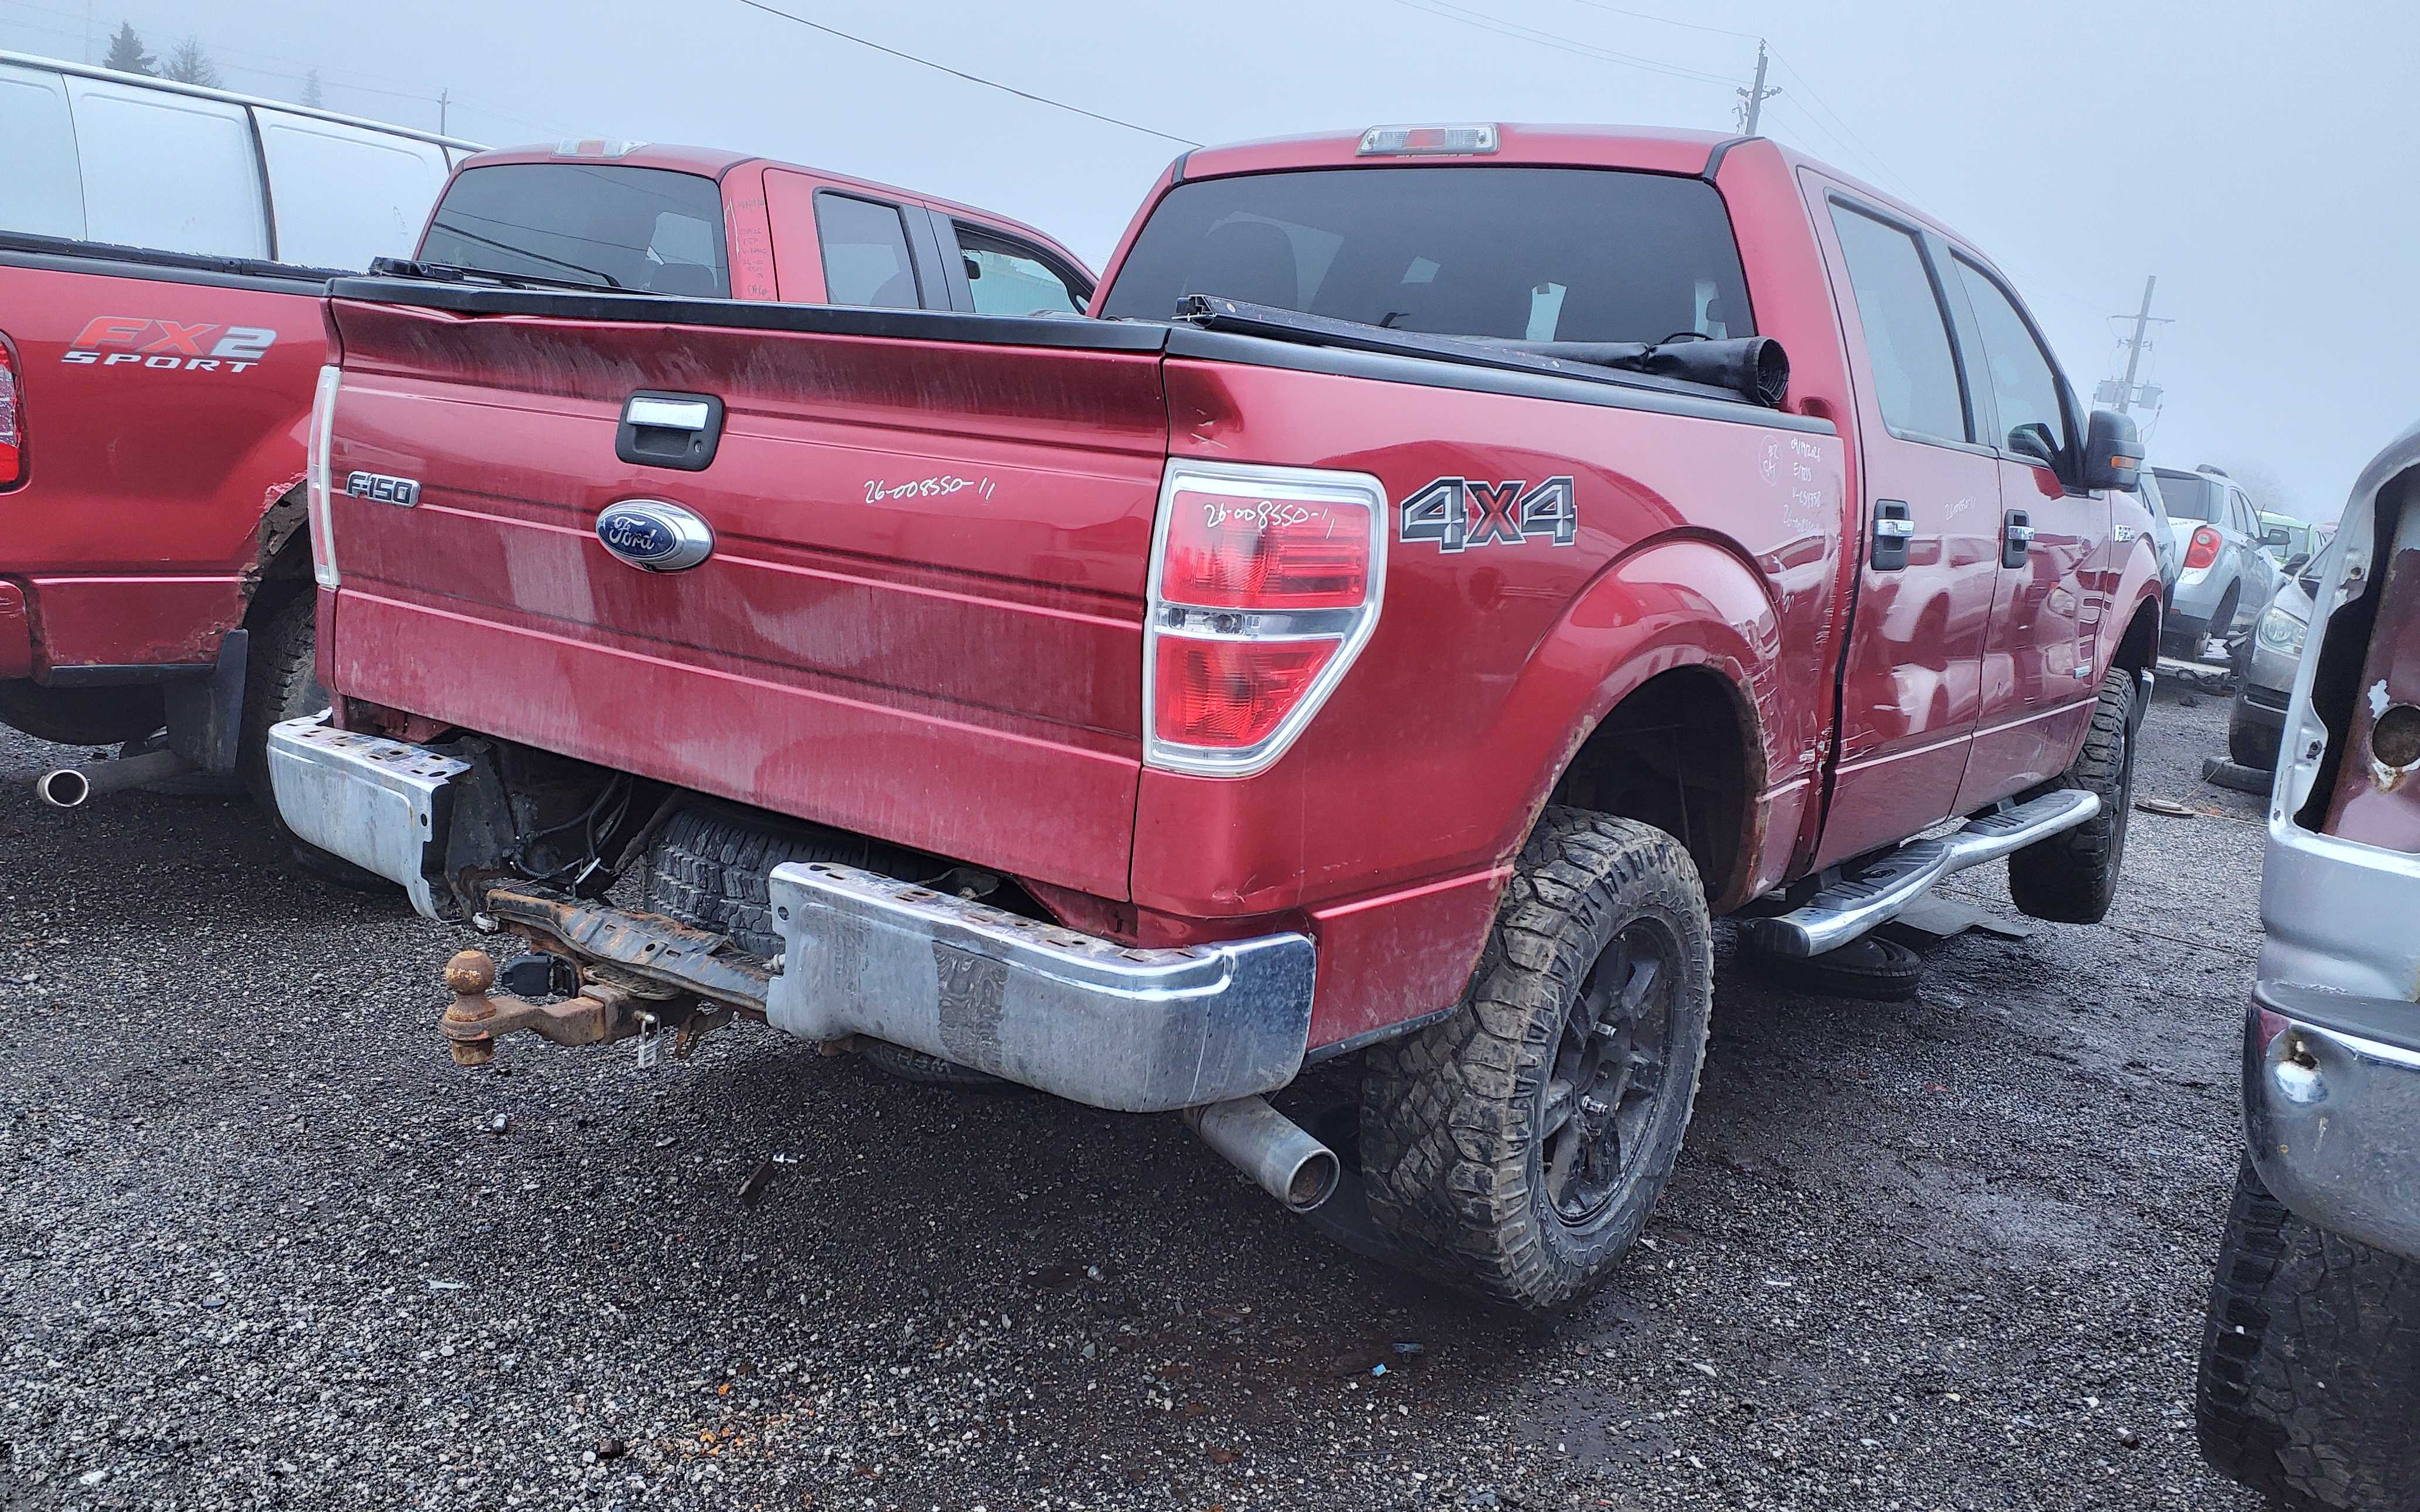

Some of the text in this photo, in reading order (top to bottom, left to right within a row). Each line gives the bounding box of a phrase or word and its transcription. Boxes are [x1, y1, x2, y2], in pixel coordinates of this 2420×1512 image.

[70, 316, 278, 359] FX2
[62, 351, 259, 373] SPORT
[609, 516, 657, 550] Ford
